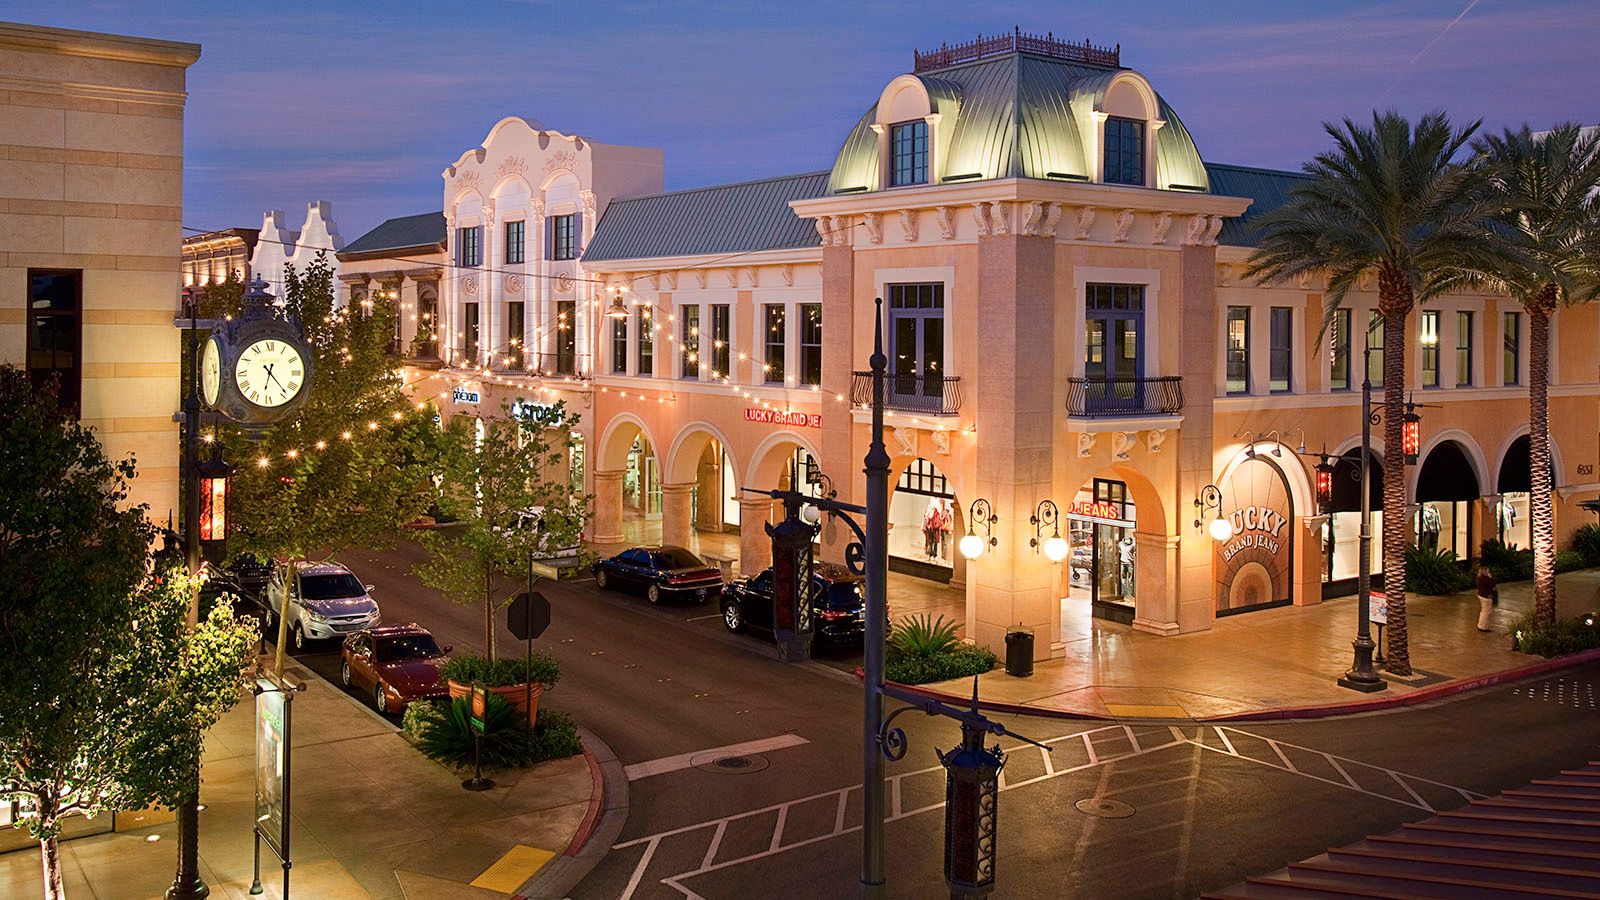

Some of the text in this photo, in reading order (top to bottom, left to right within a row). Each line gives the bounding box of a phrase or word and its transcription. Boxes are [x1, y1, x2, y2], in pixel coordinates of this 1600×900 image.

[744, 408, 823, 428] LUCKY BRAND JE
[1077, 502, 1118, 520] JEANS
[1223, 534, 1280, 562] BRAND JEANS
